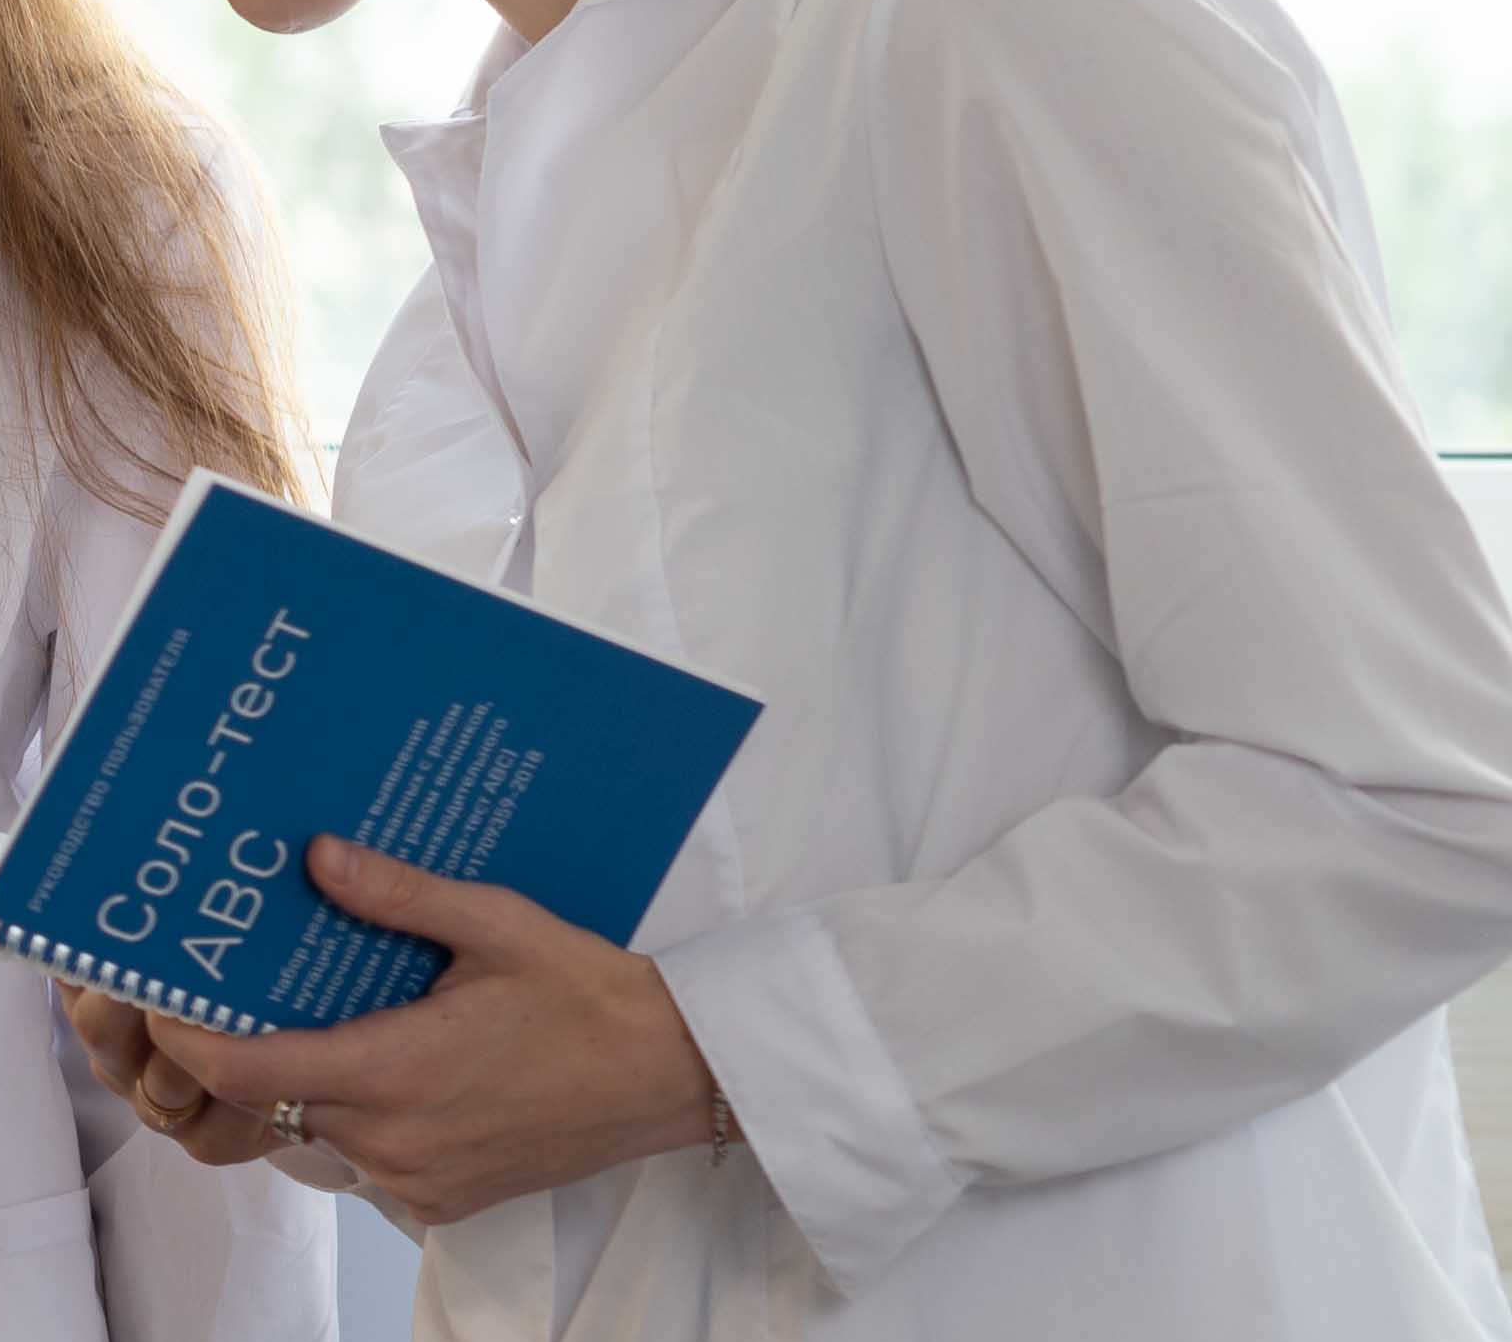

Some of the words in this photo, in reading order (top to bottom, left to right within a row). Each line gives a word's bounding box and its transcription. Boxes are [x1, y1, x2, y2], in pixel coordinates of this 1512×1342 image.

[26, 779, 111, 914] РУКОВОДСТВО
[99, 627, 192, 778] ПОЛЬЗОВАТЕЛЯ
[96, 607, 311, 943] Соло-тест
[425, 702, 466, 759] раком
[266, 946, 311, 1004] Набор
